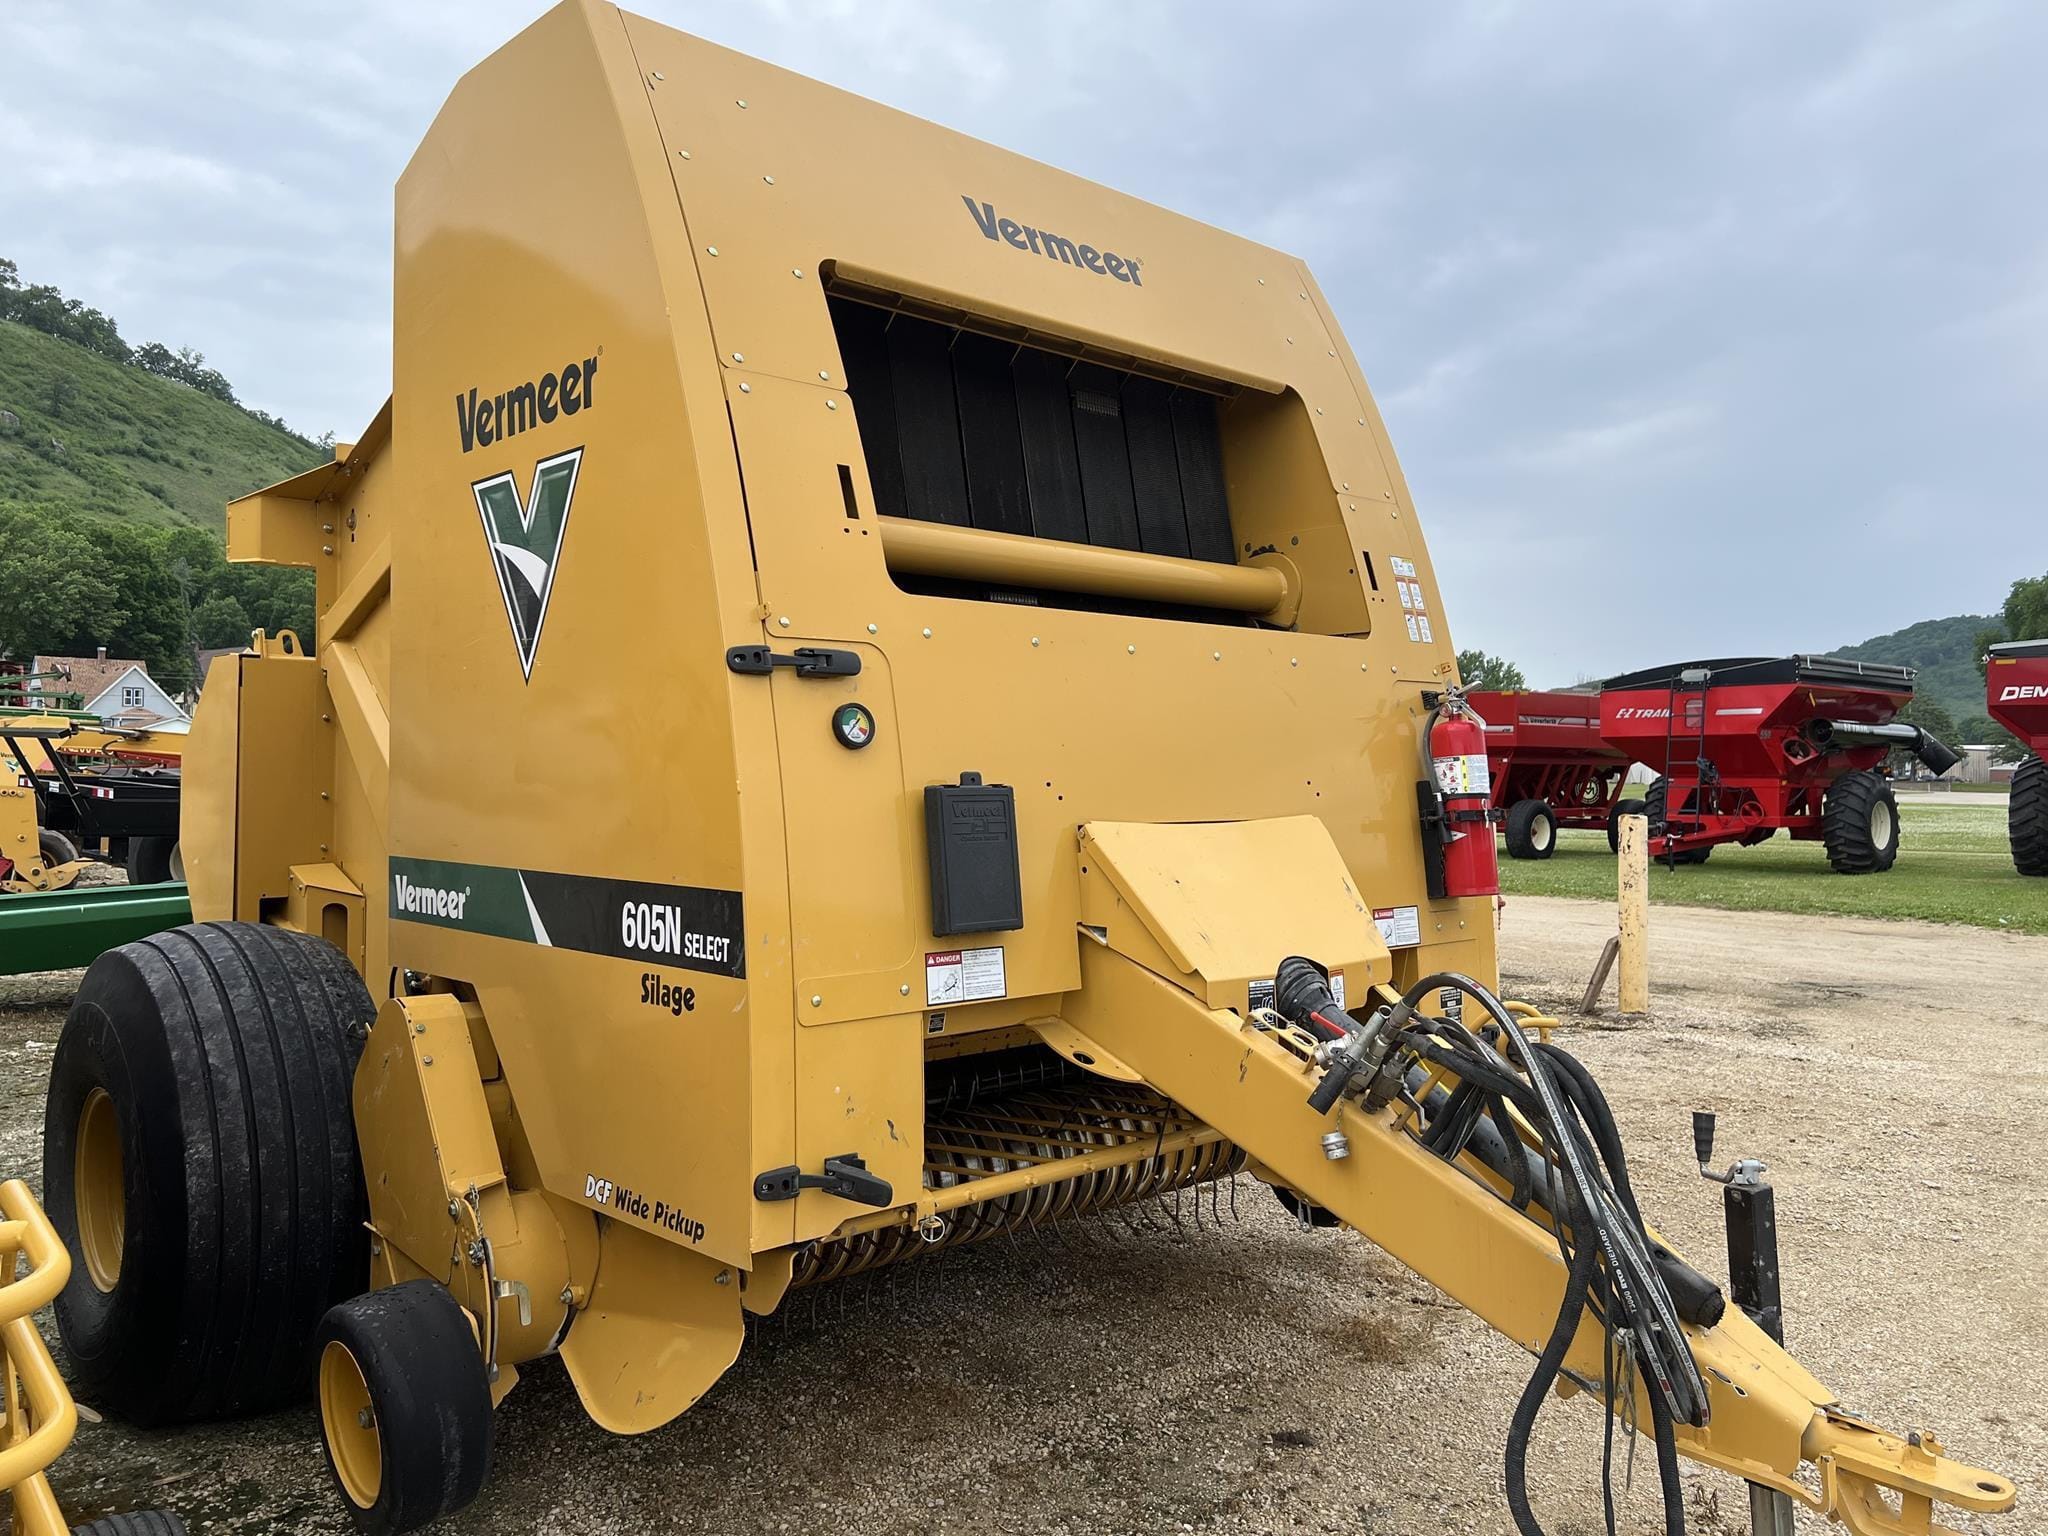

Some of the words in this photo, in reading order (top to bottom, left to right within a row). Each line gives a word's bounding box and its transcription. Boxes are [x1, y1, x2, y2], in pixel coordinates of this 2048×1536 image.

[961, 194, 1142, 287] Vermeer
[456, 356, 597, 453] Vermeer
[395, 875, 465, 919] Vermeer
[621, 901, 681, 955] 605N
[684, 933, 730, 963] SELECT
[936, 953, 961, 963] DANGER
[641, 973, 696, 1016] Silage
[585, 1173, 613, 1205] DCF
[615, 1186, 650, 1219] Wide
[653, 1201, 705, 1244] Pickup
[1597, 1228, 1620, 1267] DIEHARD
